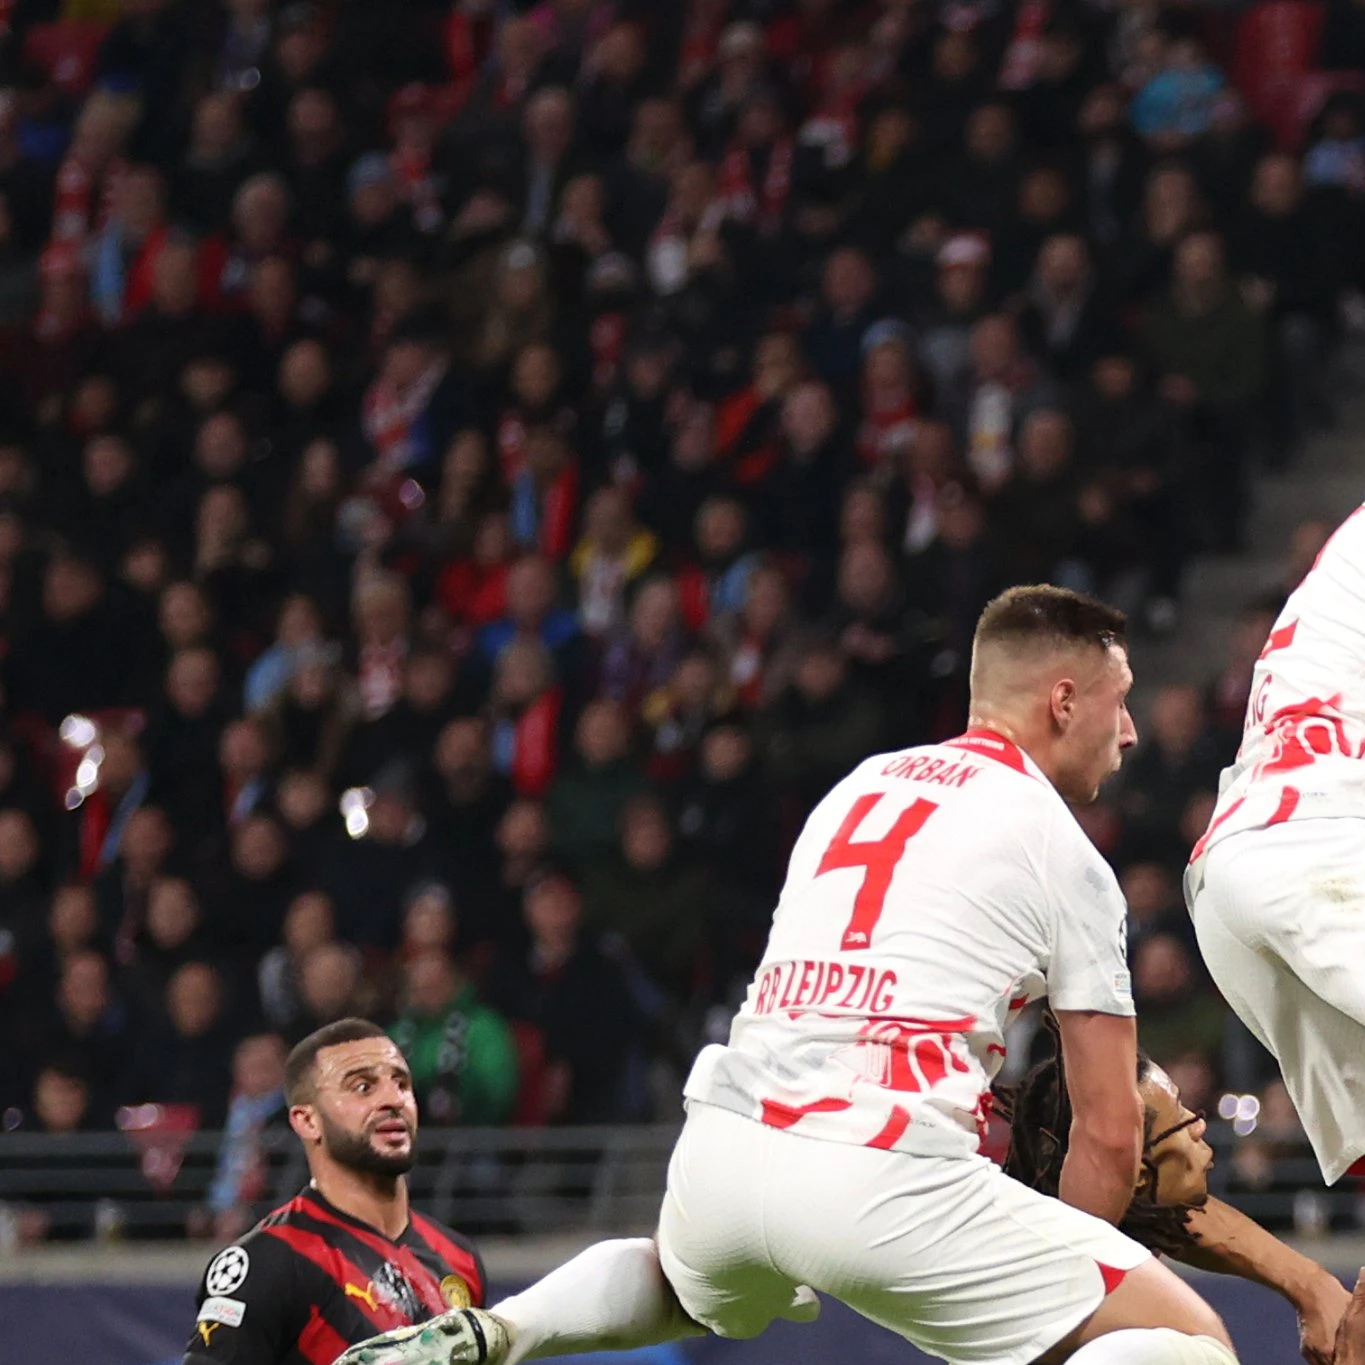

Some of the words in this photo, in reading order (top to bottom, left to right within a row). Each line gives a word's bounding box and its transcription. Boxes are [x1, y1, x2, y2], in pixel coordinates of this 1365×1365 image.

[813, 791, 940, 951] 4
[754, 965, 782, 1014] RB
[778, 959, 898, 1013] LEIPZIG
